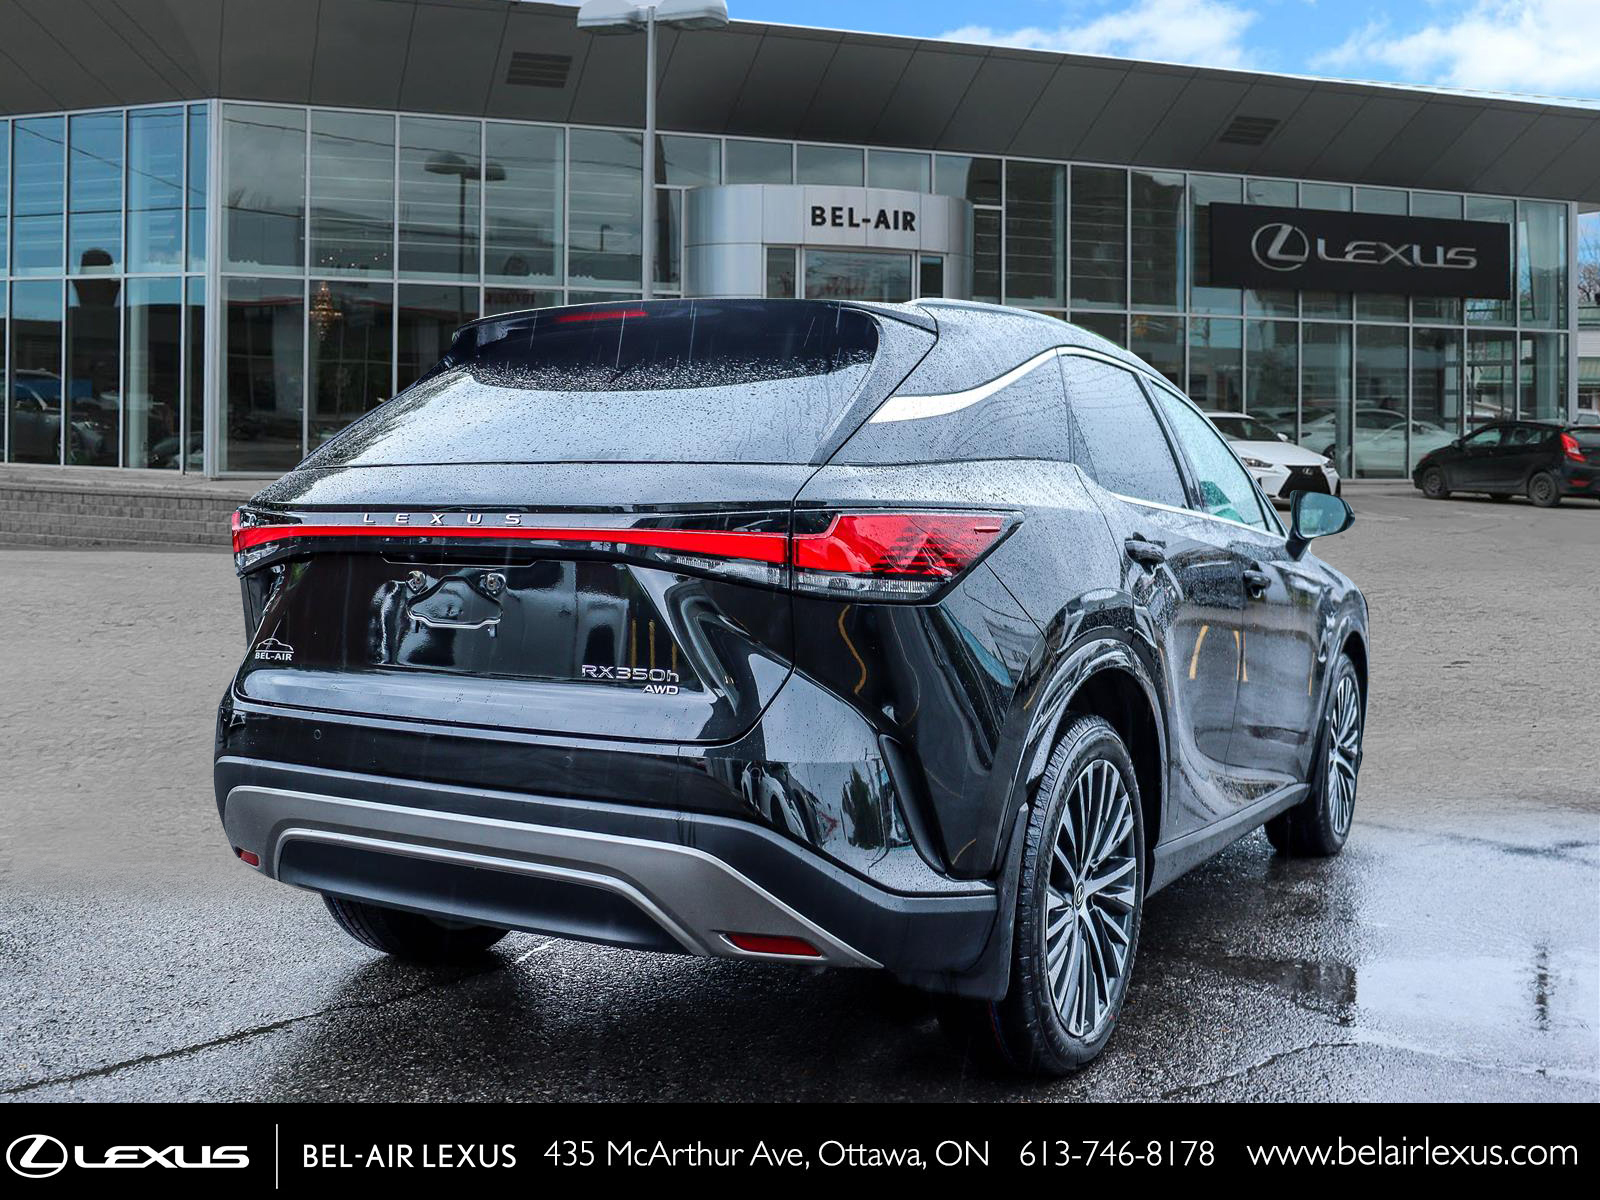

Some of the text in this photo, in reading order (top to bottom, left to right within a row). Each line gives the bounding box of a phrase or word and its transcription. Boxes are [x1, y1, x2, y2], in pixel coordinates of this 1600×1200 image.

[811, 205, 917, 232] BEL-AIR
[1316, 237, 1478, 270] LEXUS
[363, 512, 522, 526] LEXUS
[254, 652, 293, 661] BEL-AIR
[581, 664, 680, 683] RX350h
[642, 684, 679, 696] AWD
